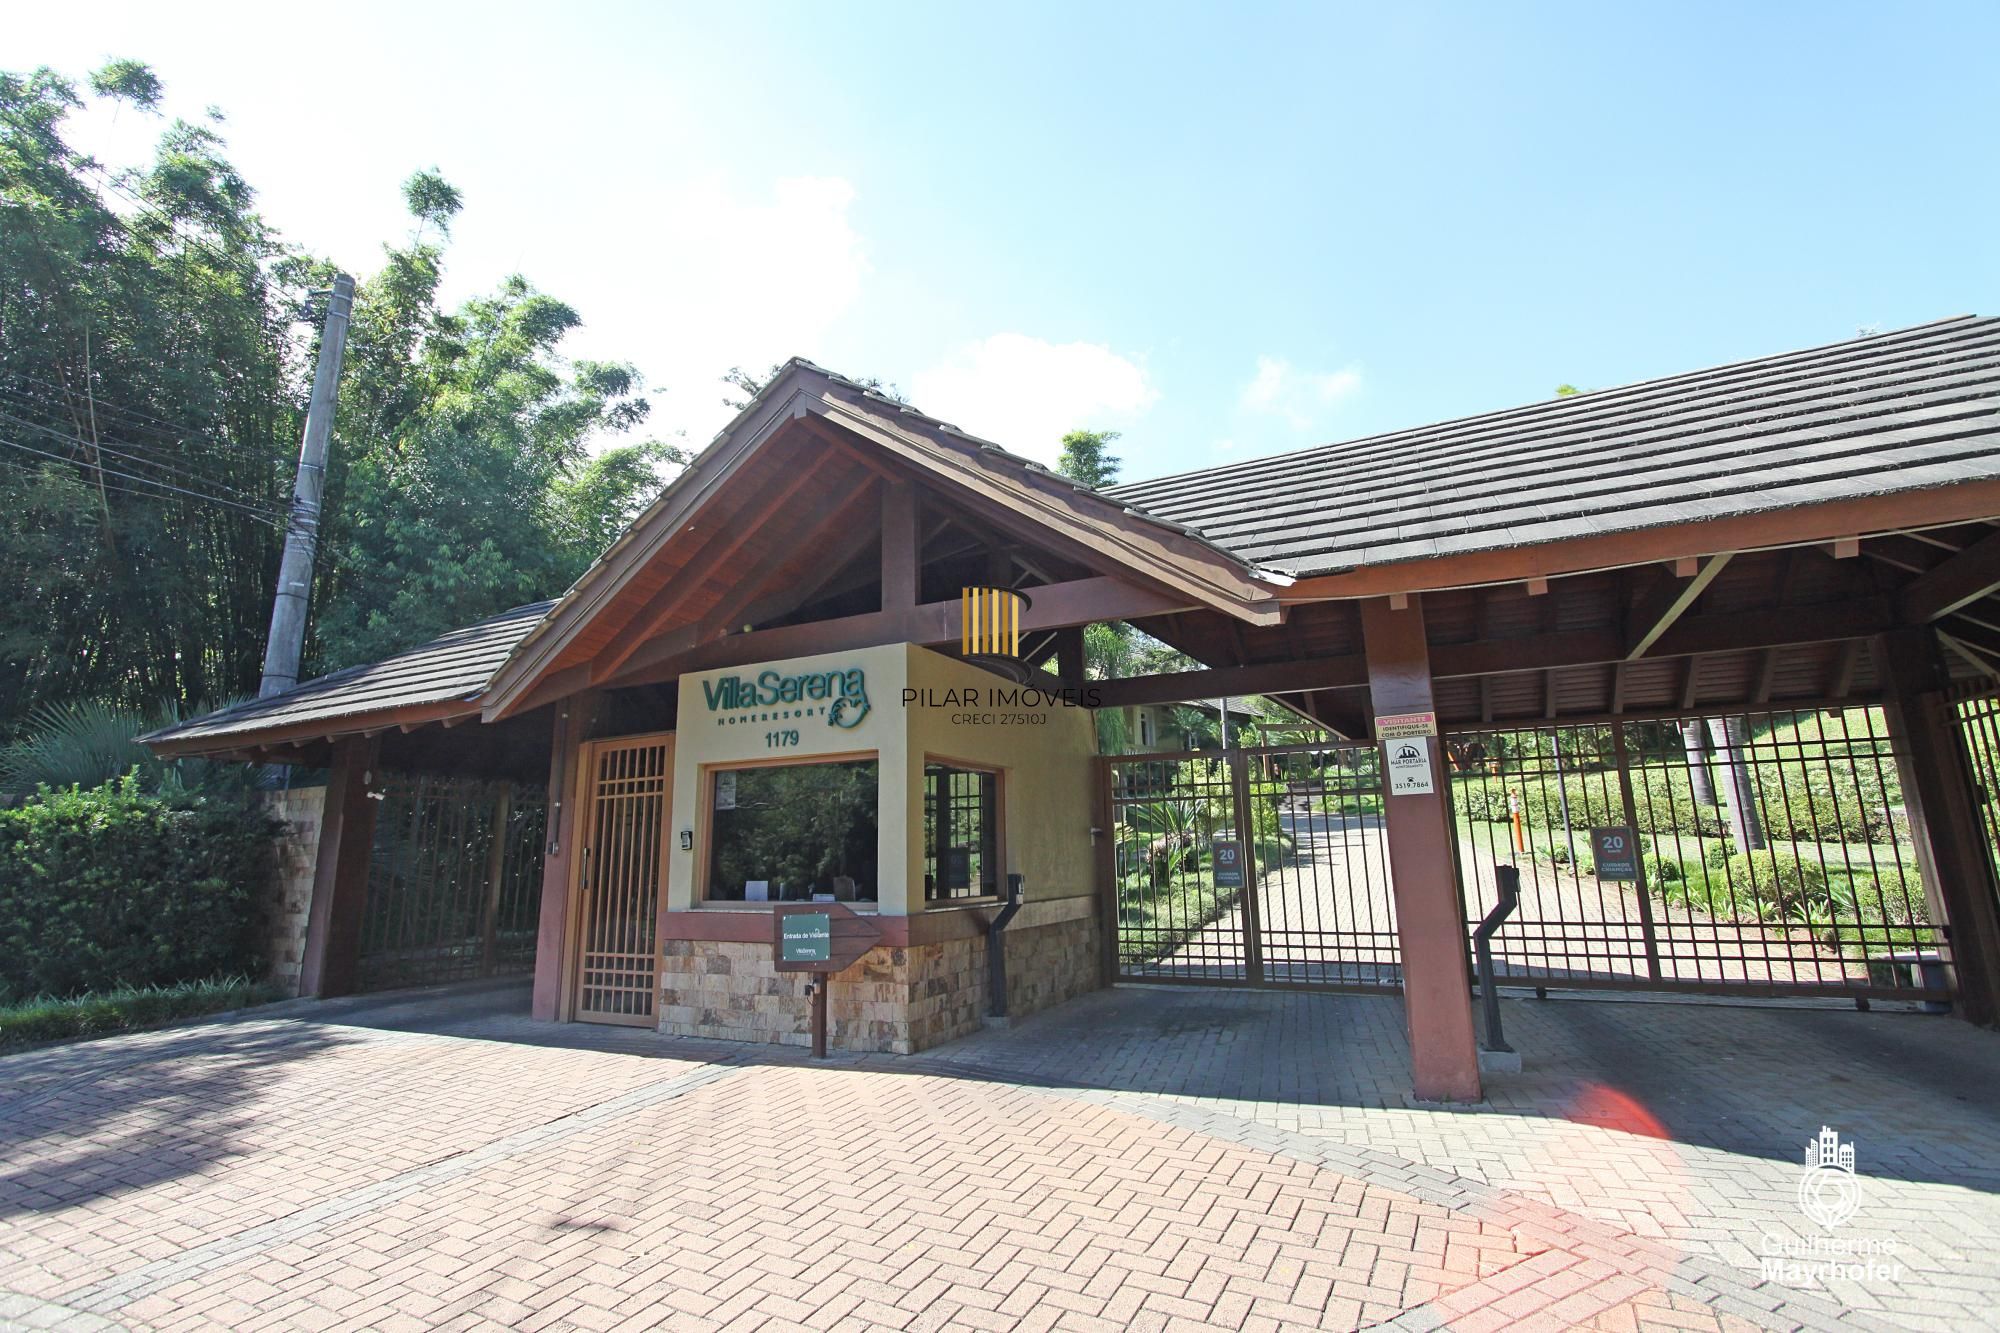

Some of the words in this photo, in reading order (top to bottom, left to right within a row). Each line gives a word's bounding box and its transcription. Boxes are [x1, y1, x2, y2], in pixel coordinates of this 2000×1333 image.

[1383, 716, 1426, 724] VISITANTE
[1382, 723, 1429, 732] IDENTIFIQUE-SE
[765, 730, 800, 748] 1179
[1402, 757, 1427, 765] PORTARIA
[1602, 836, 1624, 849] 20
[1219, 849, 1235, 860] 20
